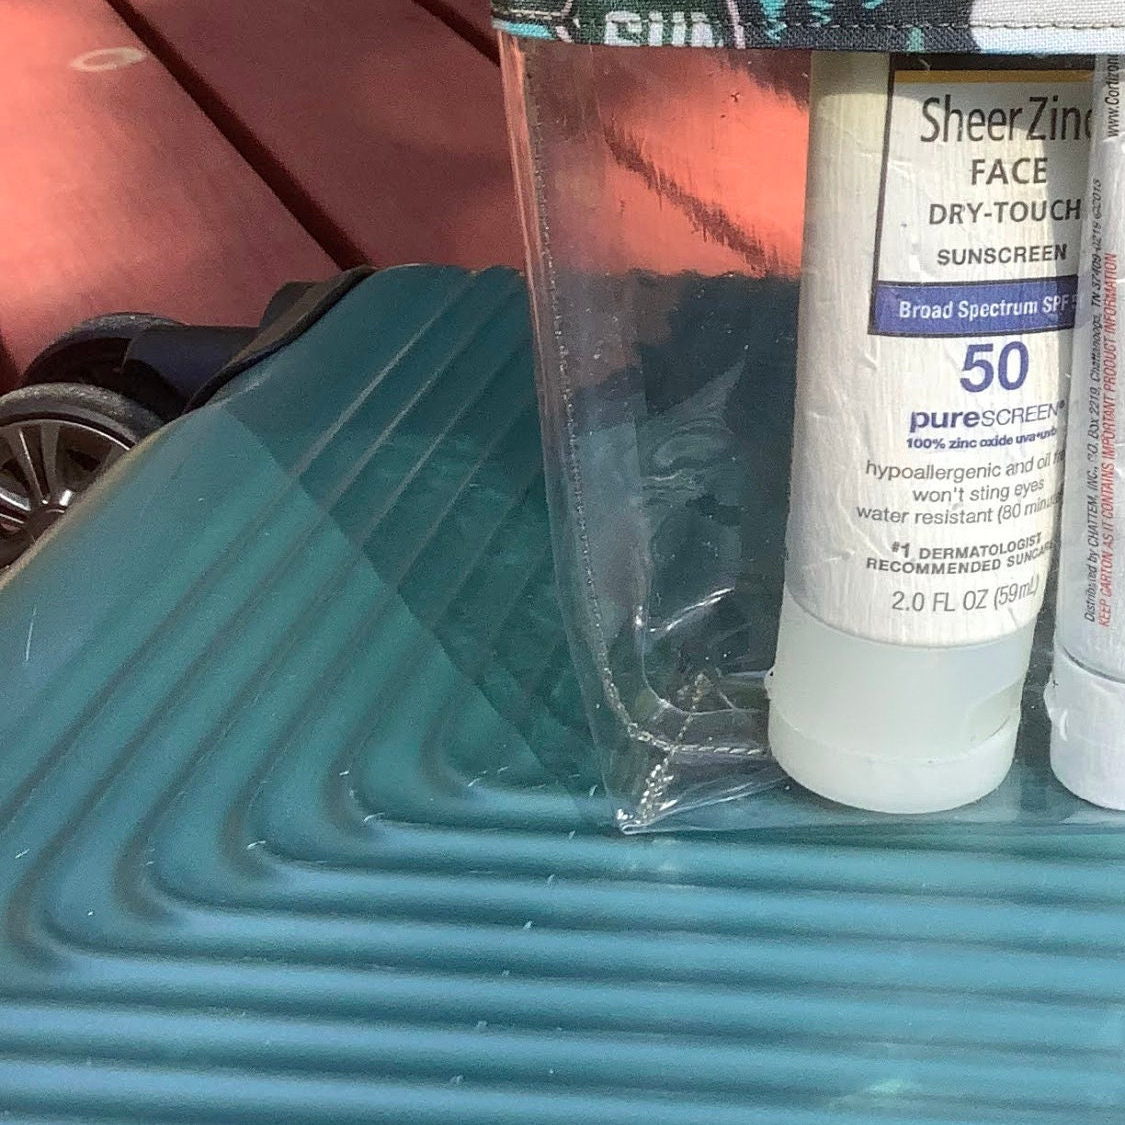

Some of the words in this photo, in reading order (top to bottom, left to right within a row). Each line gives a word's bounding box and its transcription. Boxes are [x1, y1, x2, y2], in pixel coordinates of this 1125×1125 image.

[1104, 54, 1120, 138] www.Cortizon
[970, 157, 1049, 185] FACE
[929, 198, 1082, 225] DRY-TOUCH
[936, 243, 1068, 266] SUNSCREEN
[899, 300, 953, 319] Broad
[957, 299, 1038, 321] Spectrum
[1042, 294, 1070, 313] SPF
[1091, 289, 1101, 307] TN
[1102, 254, 1118, 335] INFORMATION
[960, 340, 1030, 393] 50
[1102, 338, 1117, 392] PRODUCT
[1101, 393, 1116, 460] IMPORTANT
[906, 437, 946, 449] 100%
[949, 438, 977, 449] zinc
[980, 433, 1014, 447] oxide
[866, 459, 1001, 483] hypoallergenic
[1006, 456, 1034, 476] and
[1037, 451, 1051, 470] oil
[912, 486, 965, 502] won't
[969, 486, 1010, 503] sting
[1014, 478, 1045, 498] eyes
[1101, 462, 1115, 519] CONTAINS
[856, 505, 910, 524] water
[914, 506, 993, 525] resistant
[997, 502, 1021, 524] (80
[1102, 521, 1114, 533] IT
[891, 541, 910, 558] #1
[919, 531, 1042, 559] DERMATOLOGIST
[1089, 548, 1100, 560] by
[1102, 535, 1114, 549] AS
[866, 557, 1001, 575] RECOMMENDED
[1099, 553, 1114, 597] CARTON
[892, 590, 925, 612] 2.0
[932, 592, 956, 612] FL
[963, 588, 989, 611] OZ
[993, 574, 1041, 611] (59mL)
[1098, 599, 1112, 627] KEEP
